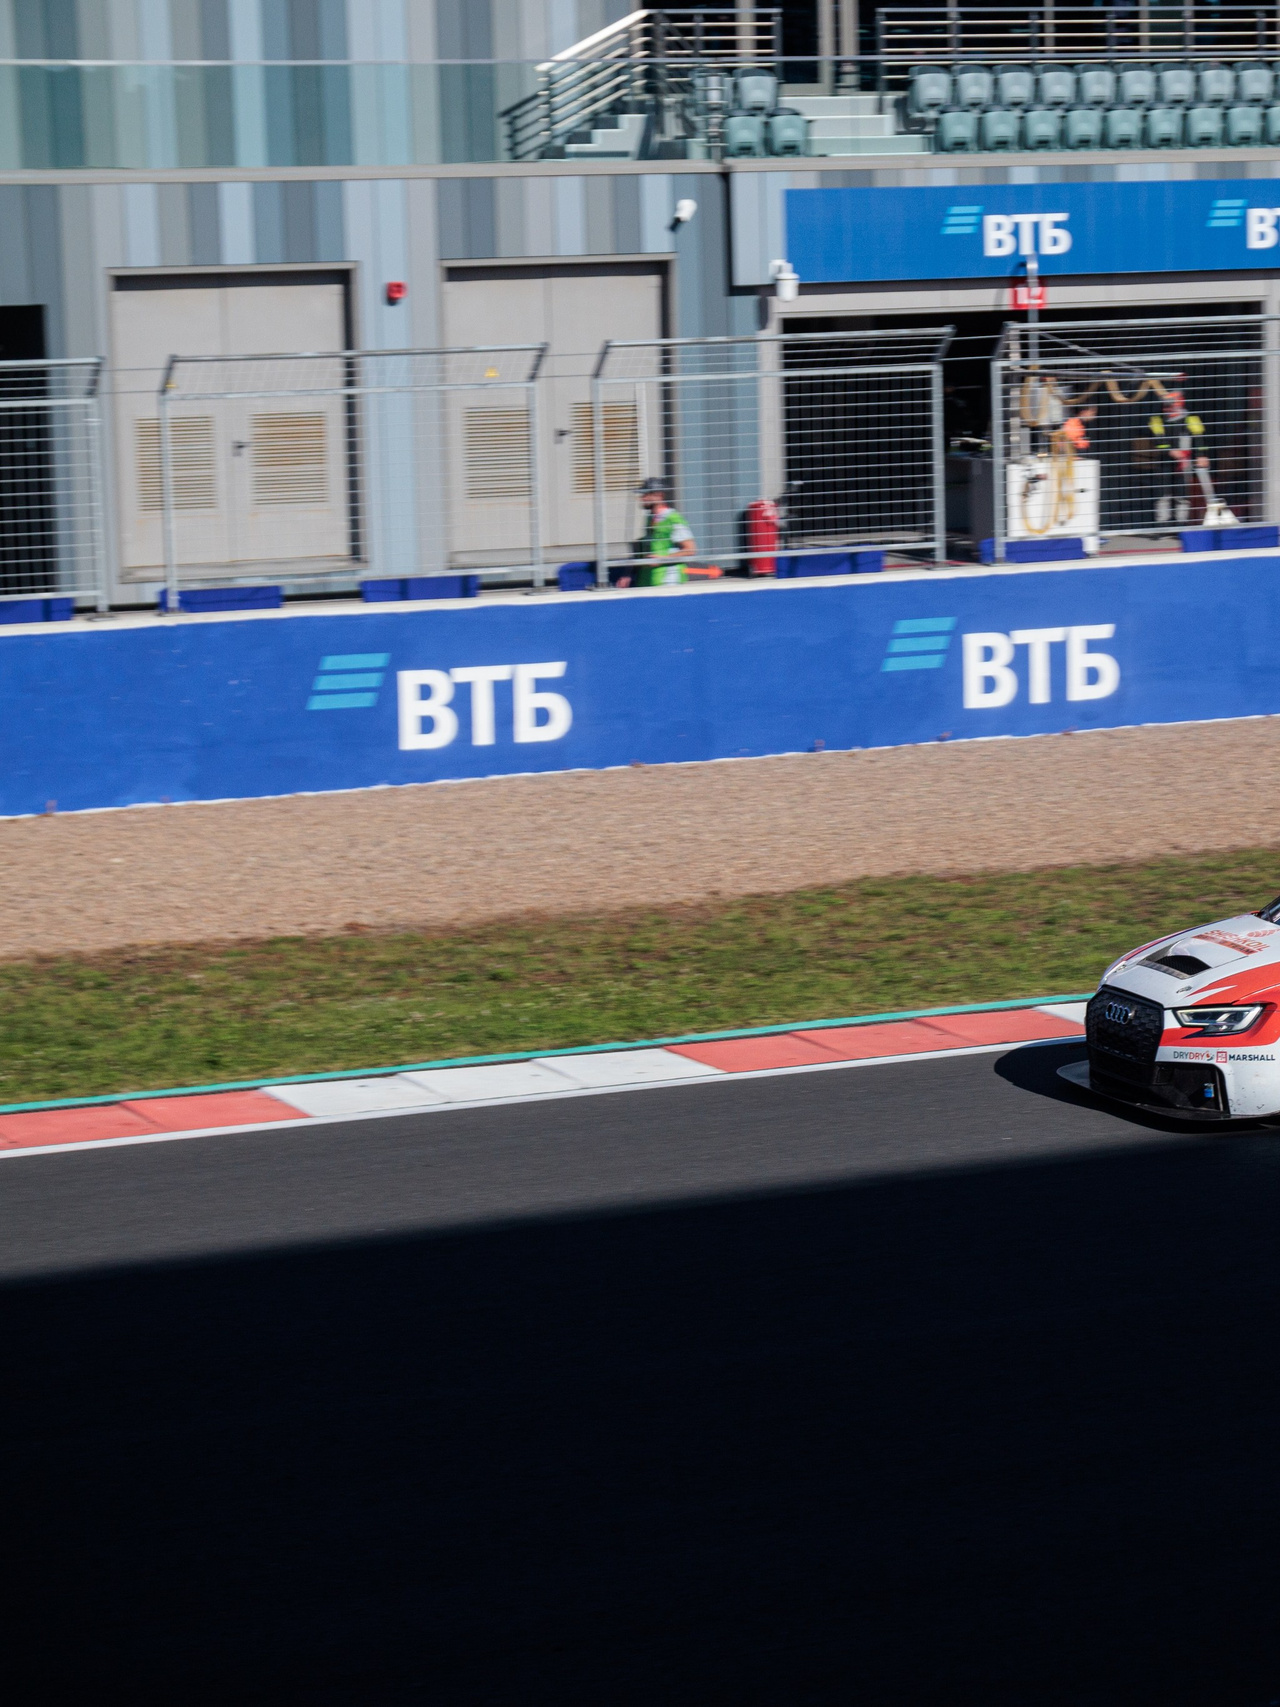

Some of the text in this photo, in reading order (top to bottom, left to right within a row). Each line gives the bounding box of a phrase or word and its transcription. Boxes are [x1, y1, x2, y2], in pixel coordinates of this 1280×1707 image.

[983, 211, 1073, 257] ВТБ
[961, 622, 1121, 710] ВТБ
[396, 660, 574, 752] ВТБ
[1173, 1051, 1205, 1060] DRYDRY
